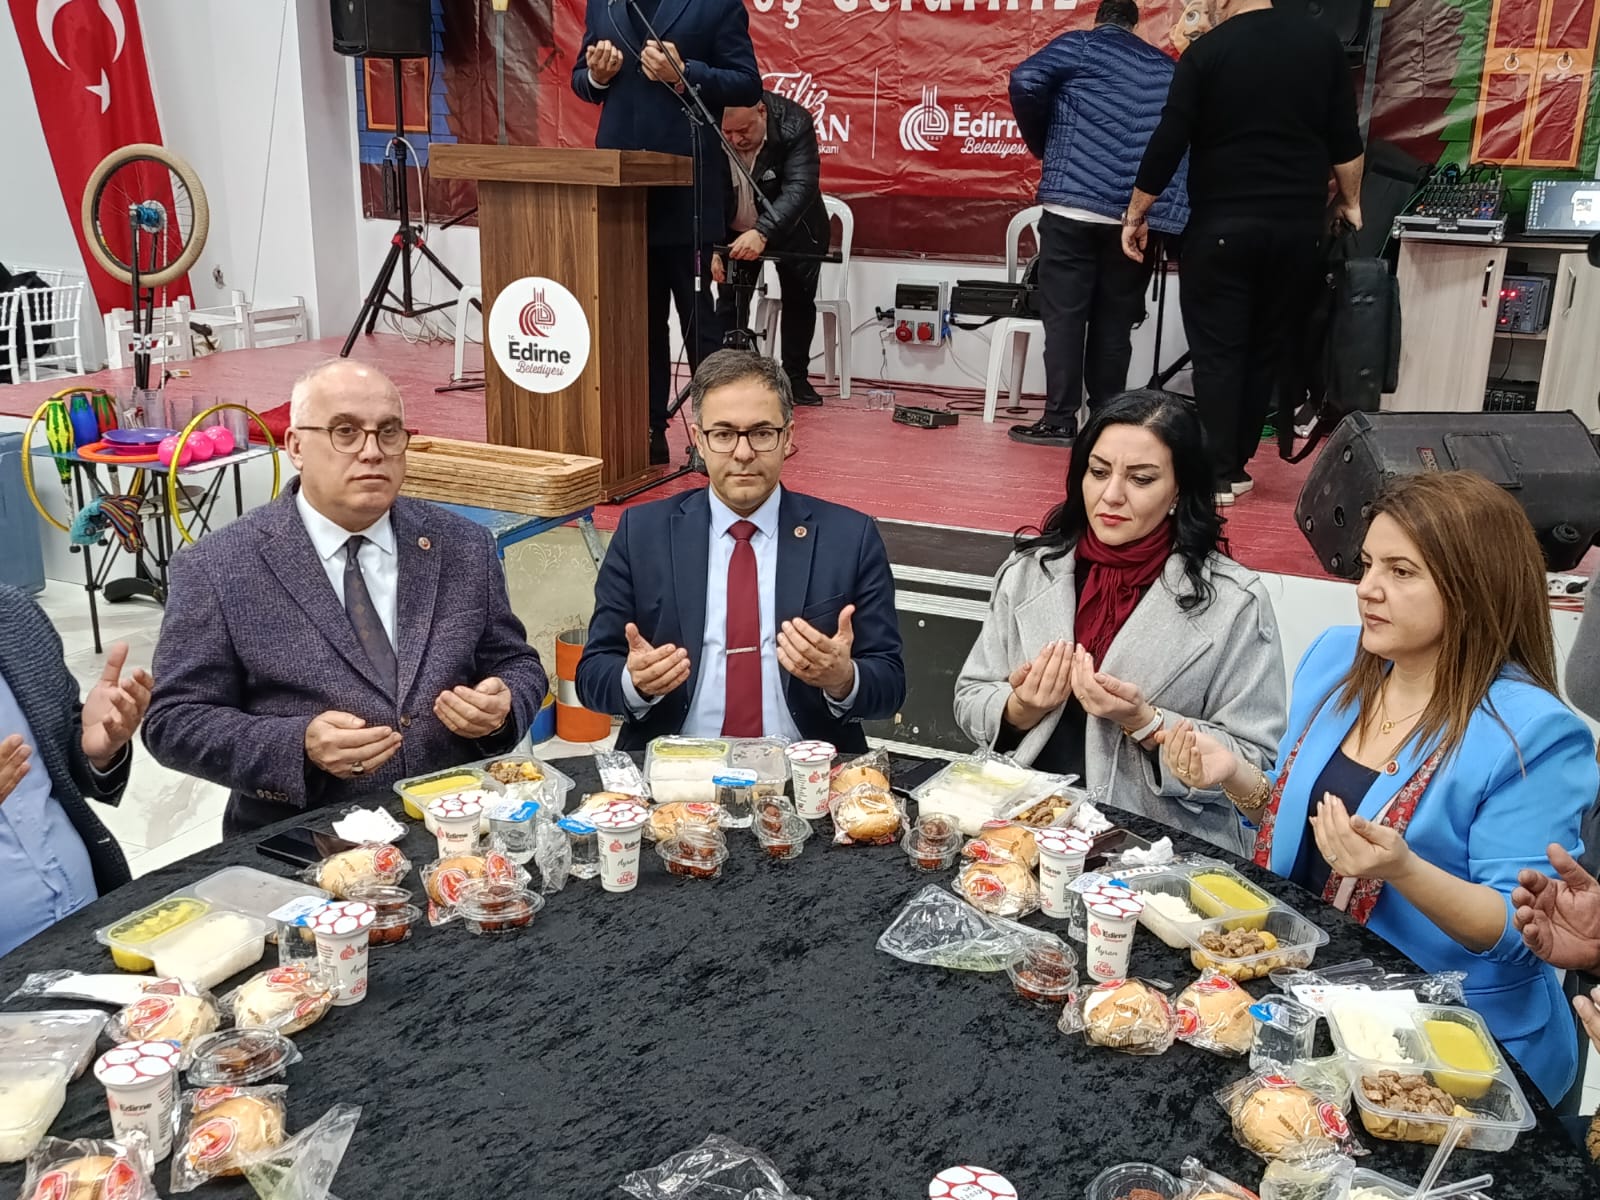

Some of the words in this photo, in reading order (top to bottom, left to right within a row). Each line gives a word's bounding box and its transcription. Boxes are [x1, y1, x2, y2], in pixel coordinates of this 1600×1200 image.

[953, 111, 1022, 139] Edirn
[960, 137, 1028, 159] Belediyesi
[508, 341, 572, 365] Edirne
[516, 360, 565, 379] Belediyesi
[1102, 928, 1127, 939] Edirne
[1095, 945, 1118, 957] Ayran
[119, 1102, 153, 1113] Edirne
